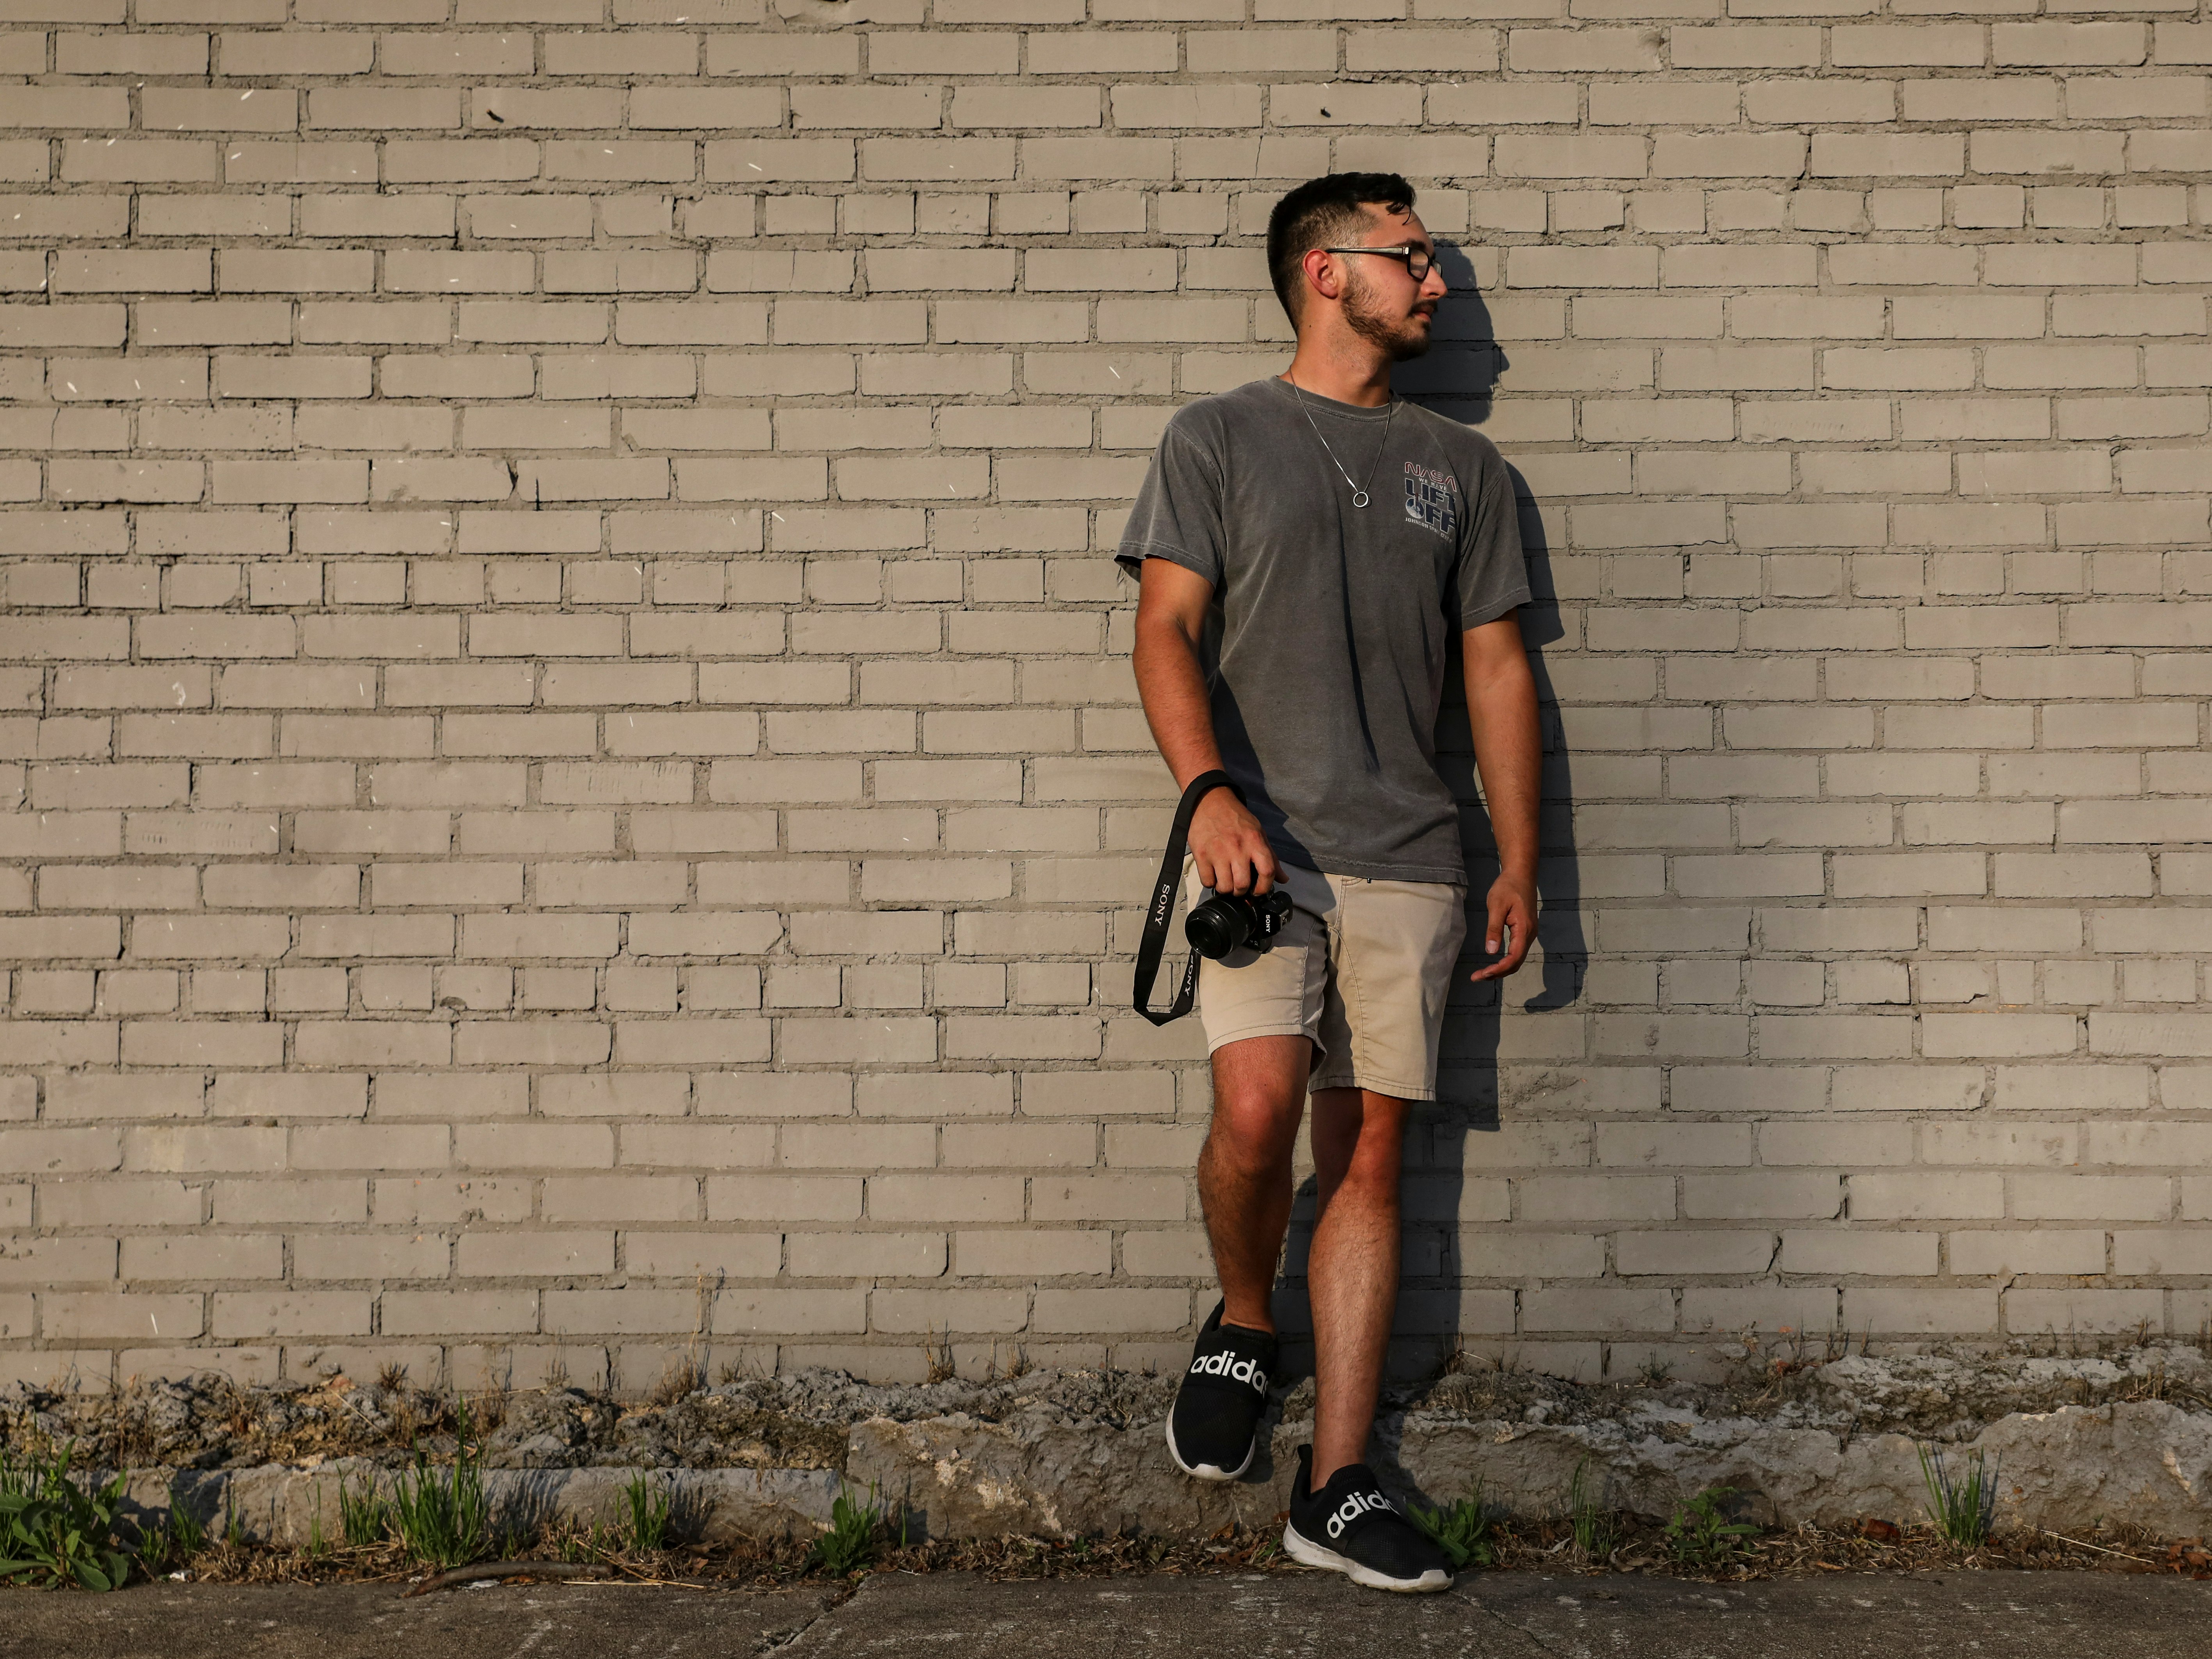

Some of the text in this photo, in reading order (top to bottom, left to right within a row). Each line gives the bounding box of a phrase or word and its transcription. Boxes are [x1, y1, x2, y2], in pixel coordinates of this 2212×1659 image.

[1405, 462, 1457, 492] NASA
[1431, 482, 1448, 491] HAVE
[1405, 478, 1456, 513] LIFT
[1405, 517, 1428, 529] JOHNSON
[1154, 884, 1170, 927] SONY
